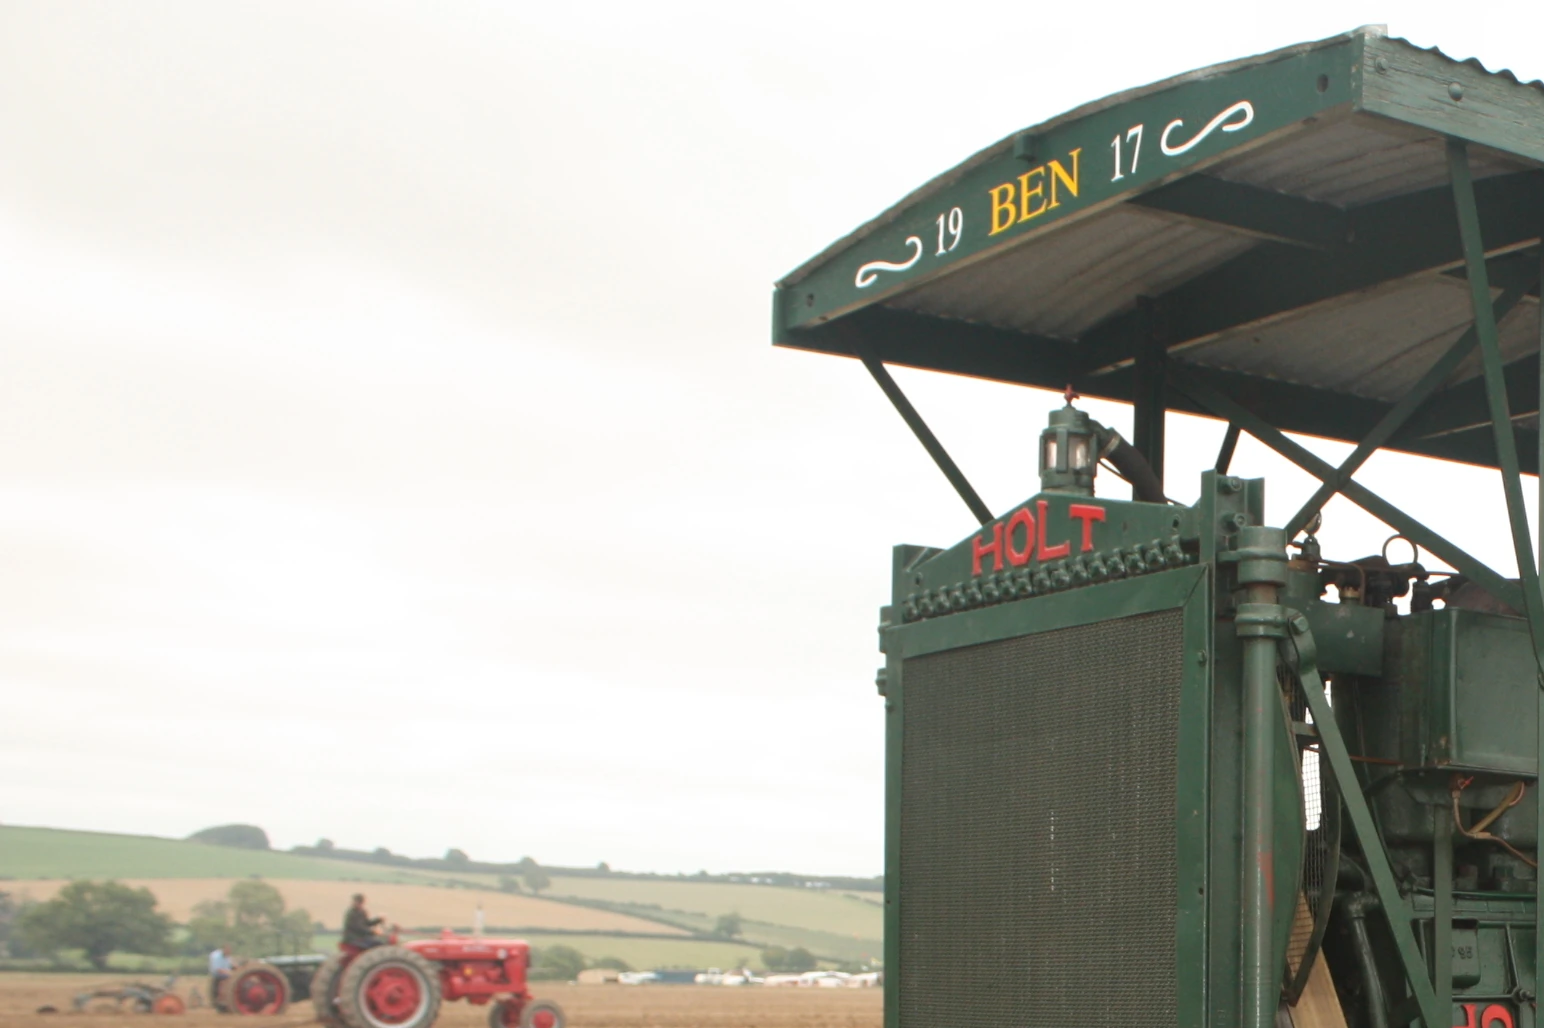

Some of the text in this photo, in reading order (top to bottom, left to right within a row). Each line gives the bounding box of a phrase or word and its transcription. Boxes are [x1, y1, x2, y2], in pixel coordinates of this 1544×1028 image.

[935, 123, 1144, 257] 19 BEN 17
[972, 499, 1107, 576] HOLT
